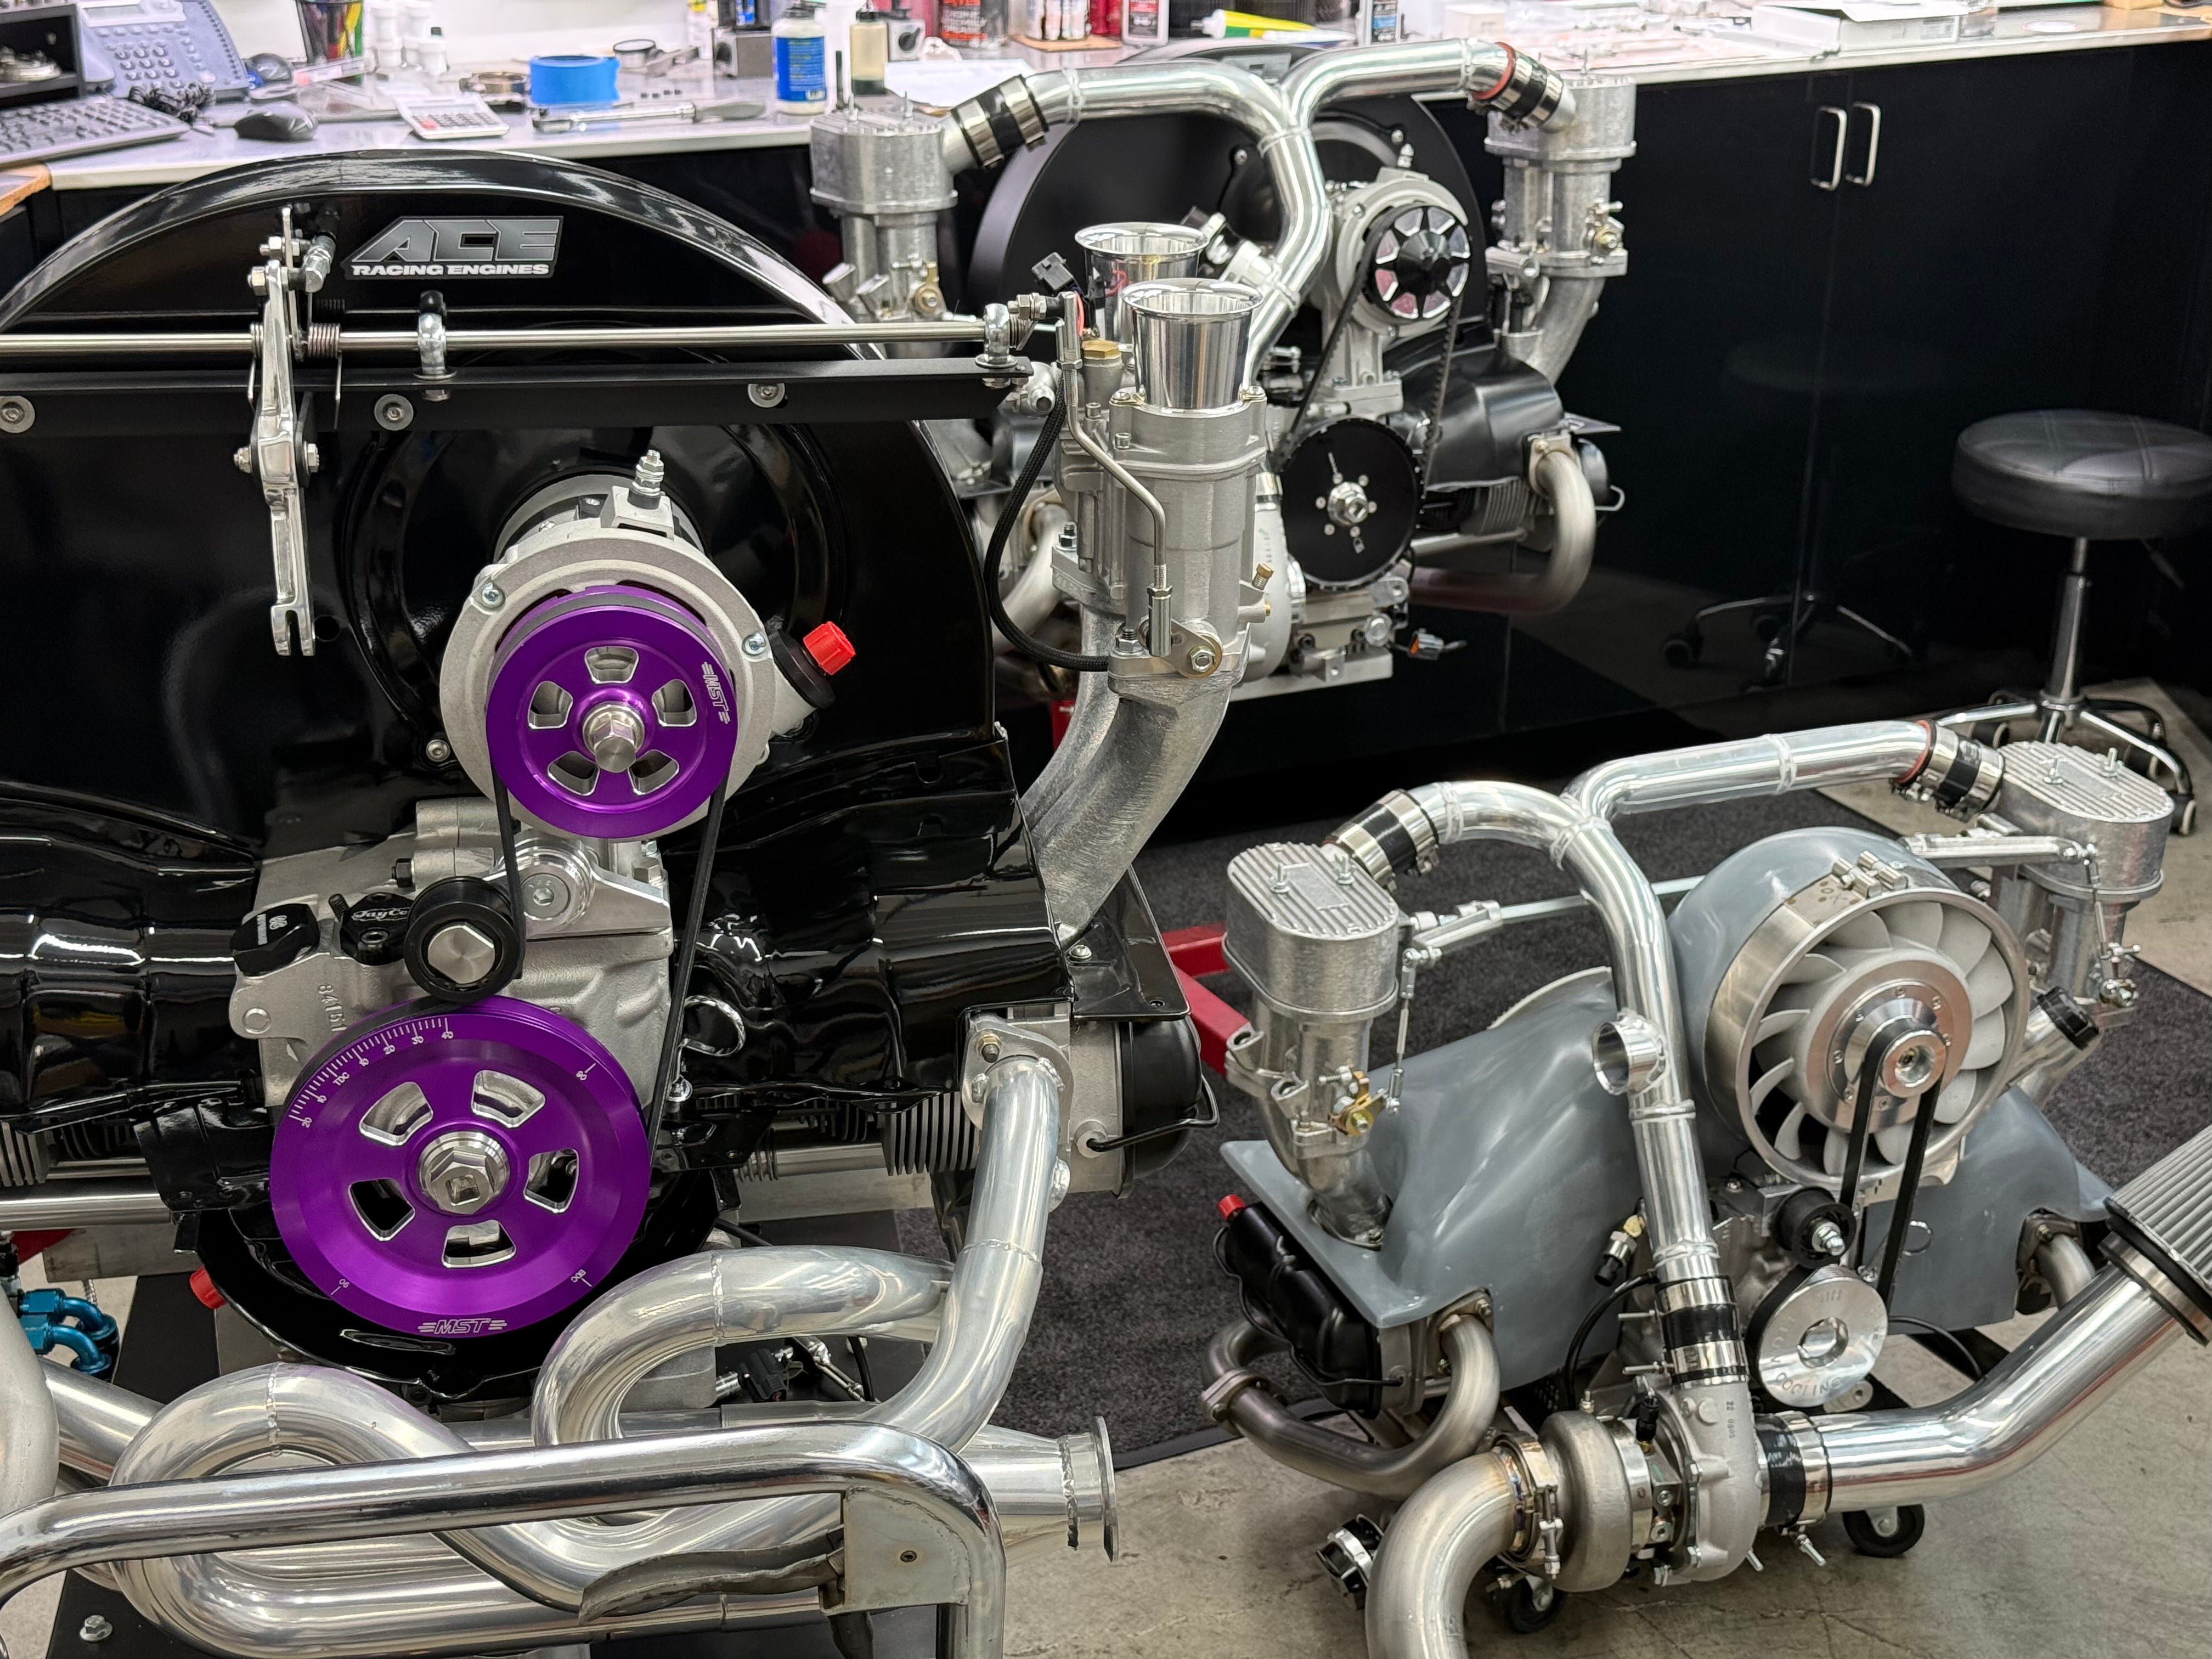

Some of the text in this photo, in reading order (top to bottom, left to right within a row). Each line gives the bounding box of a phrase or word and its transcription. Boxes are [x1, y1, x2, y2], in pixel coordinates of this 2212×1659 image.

[351, 220, 560, 262] ACE
[351, 264, 549, 276] RACING ENGINES
[703, 674, 730, 712] MST
[351, 908, 408, 922] JayCe
[302, 1117, 313, 1128] 20
[332, 1072, 350, 1086] TDC
[383, 1045, 396, 1055] 20
[411, 1036, 424, 1045] 30
[441, 1031, 454, 1040] 40
[571, 1268, 587, 1283] BDC
[434, 1318, 492, 1335] MST
